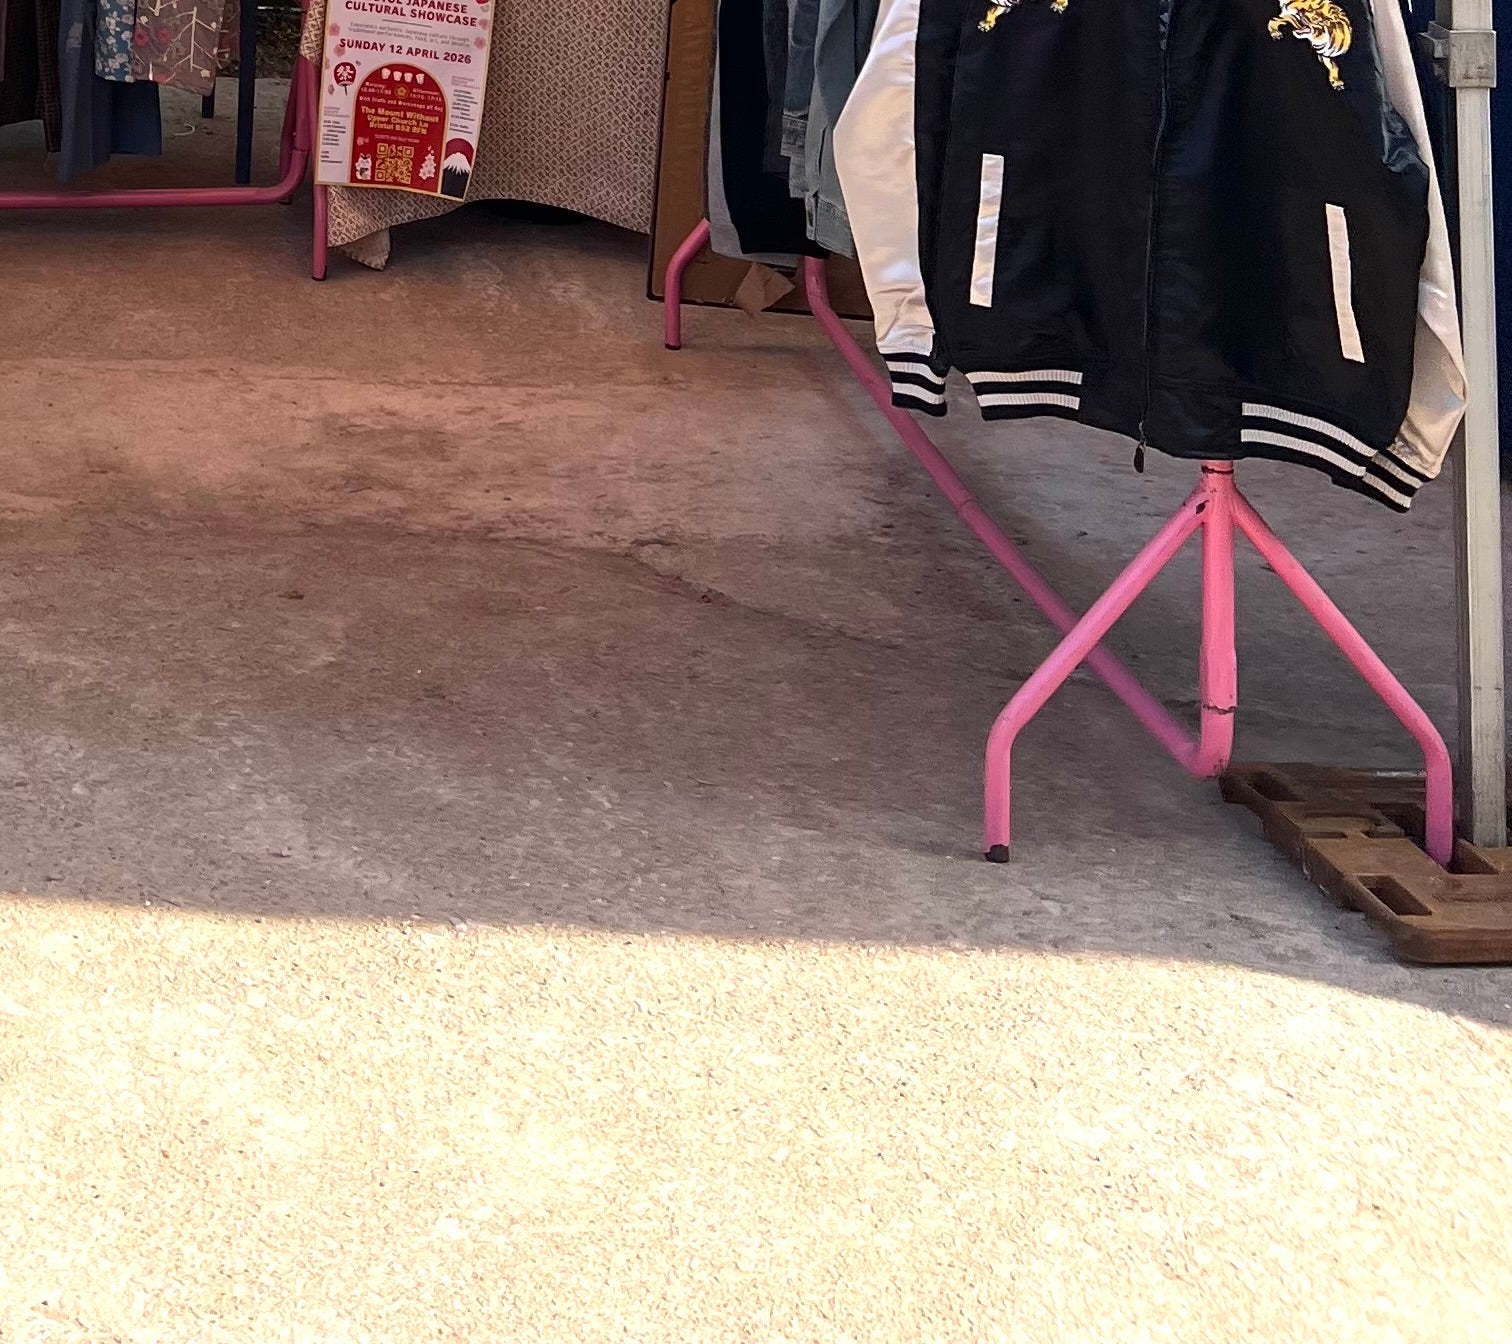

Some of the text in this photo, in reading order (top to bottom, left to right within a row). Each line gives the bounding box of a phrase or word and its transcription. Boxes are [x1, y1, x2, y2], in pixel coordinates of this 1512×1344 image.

[345, 0, 478, 27] CULTURAL SHOWCASE
[339, 38, 472, 64] SUNDAY 12 APRIL 2026
[361, 105, 376, 114] The
[377, 107, 404, 118] Mount
[406, 111, 439, 123] Without
[391, 117, 417, 126] Church
[369, 122, 394, 130] Bristol
